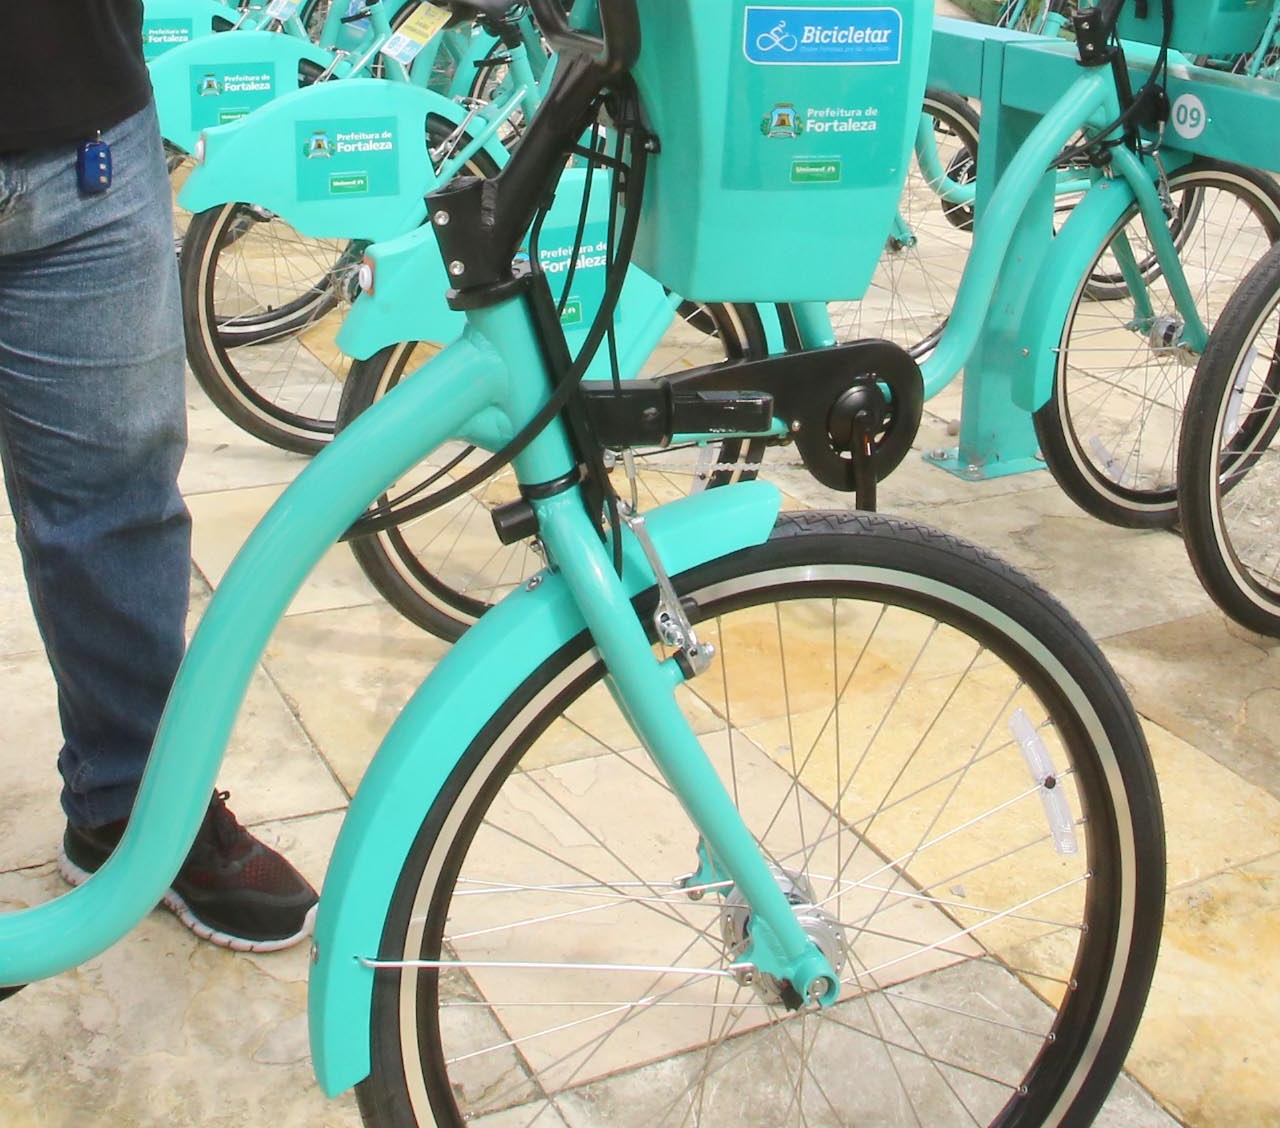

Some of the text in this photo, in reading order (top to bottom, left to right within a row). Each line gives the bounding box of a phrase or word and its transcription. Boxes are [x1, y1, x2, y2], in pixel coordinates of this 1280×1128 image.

[149, 34, 189, 43] Fortaleza
[801, 25, 892, 45] Bicicletar
[224, 73, 271, 82] Prefeitura de
[224, 81, 271, 92] Fortaleza
[807, 106, 878, 118] Prefeitura de
[1176, 103, 1201, 129] 09
[806, 118, 877, 133] Fortaleza
[336, 130, 393, 141] Prefeitura de
[336, 139, 393, 153] Fortaleza
[540, 244, 594, 260] Prefeiura
